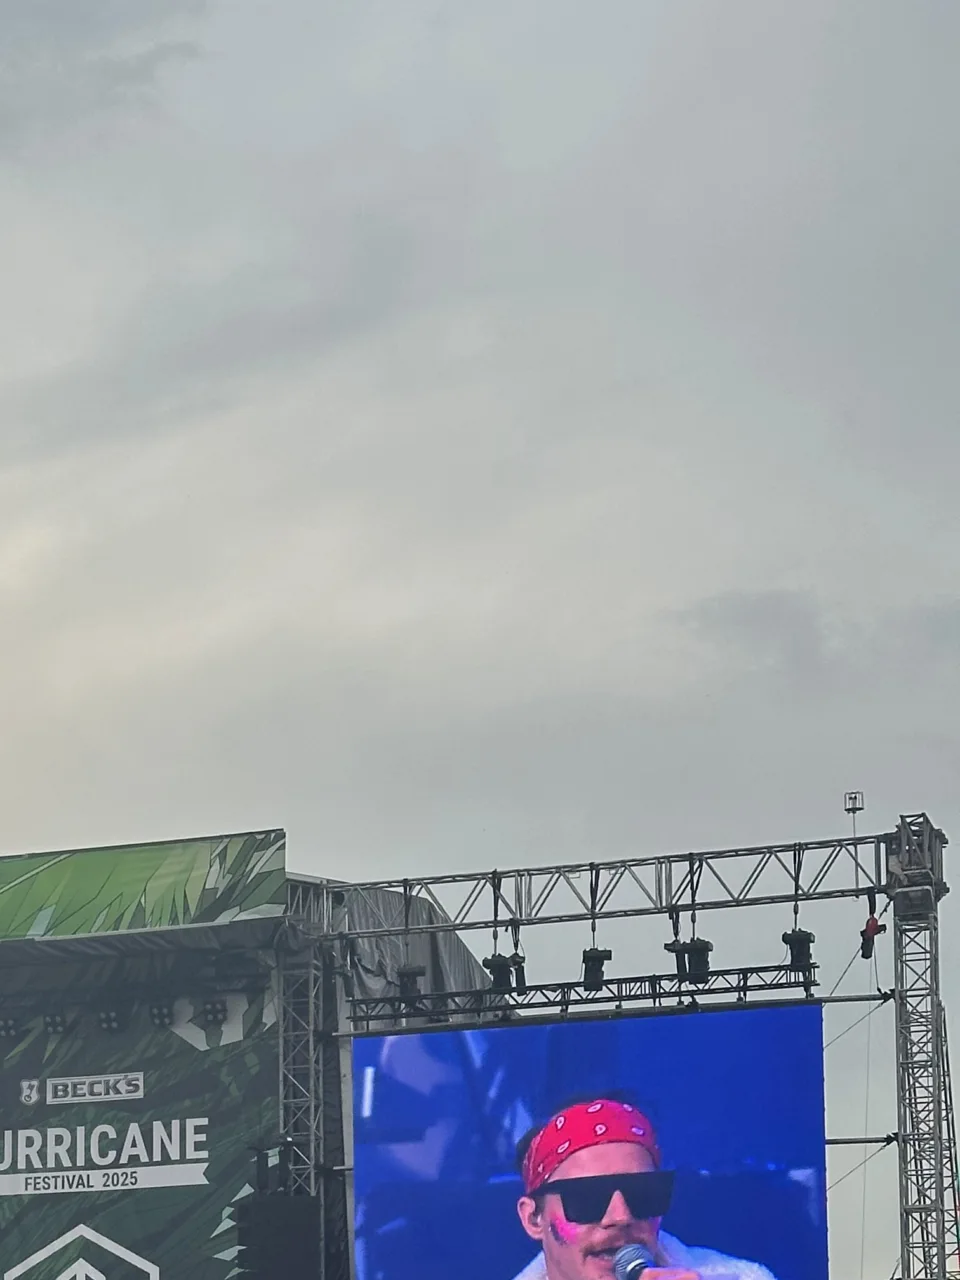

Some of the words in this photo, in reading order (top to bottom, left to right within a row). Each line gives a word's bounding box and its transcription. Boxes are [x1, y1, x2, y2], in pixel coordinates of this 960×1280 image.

[49, 1073, 142, 1102] BECK'S
[24, 1173, 94, 1191] FESTIVAL
[102, 1170, 139, 1188] 2025
